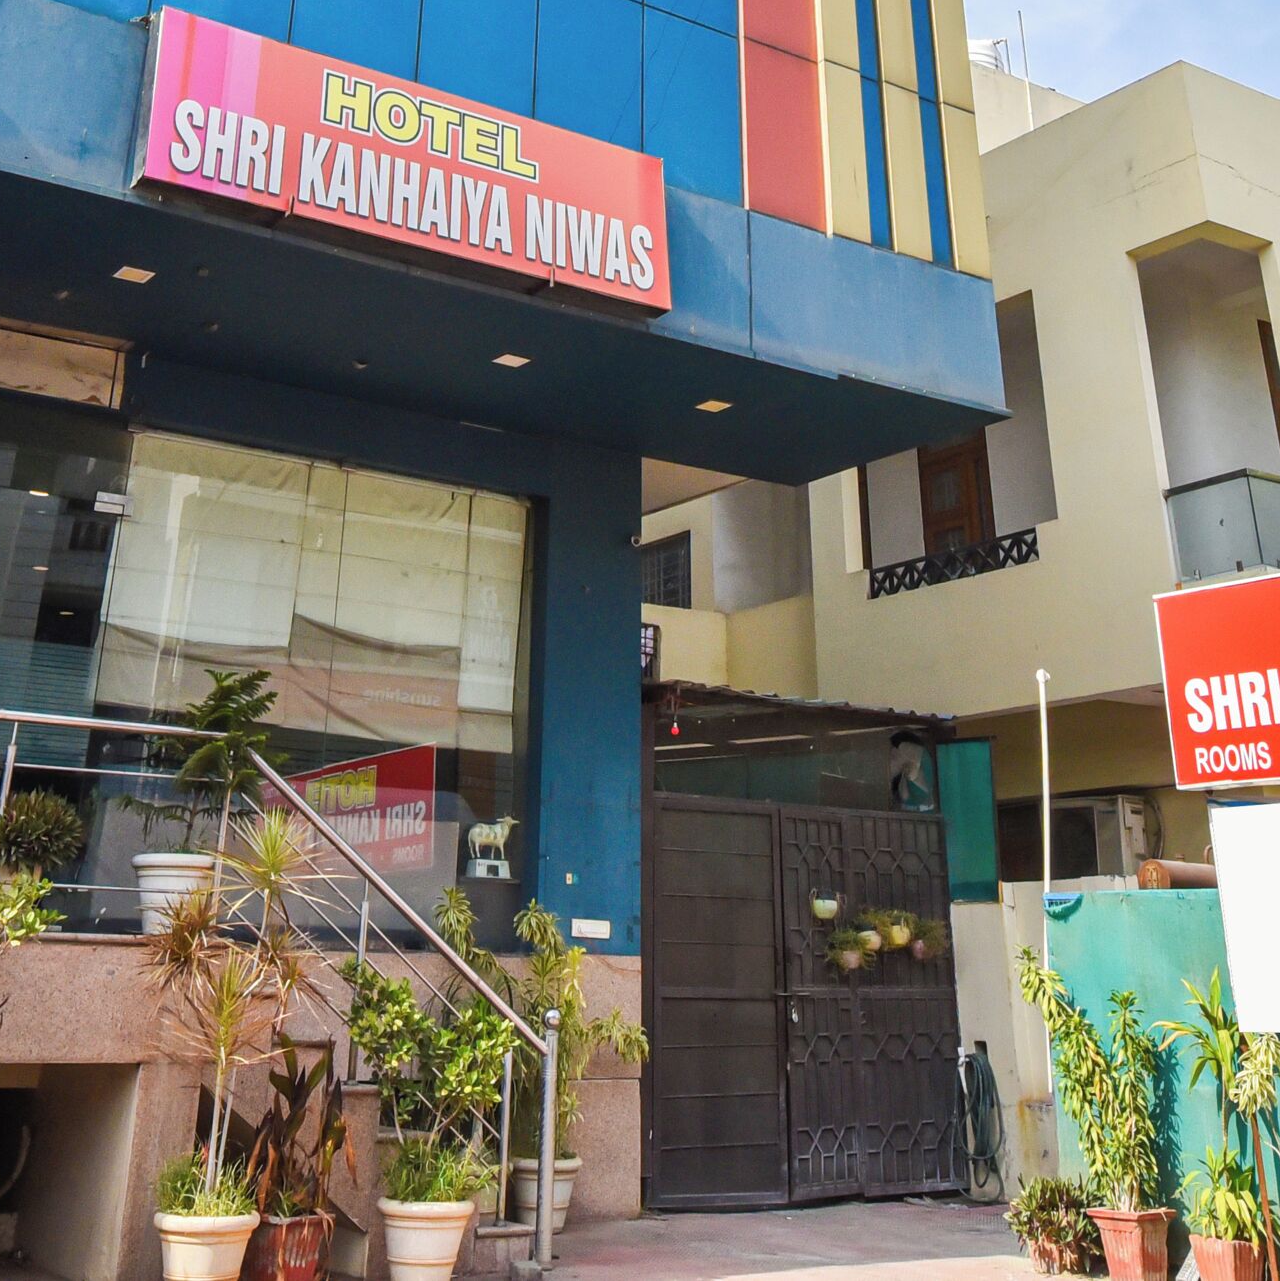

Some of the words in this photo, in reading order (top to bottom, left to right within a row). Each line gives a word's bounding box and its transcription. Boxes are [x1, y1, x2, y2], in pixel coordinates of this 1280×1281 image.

[321, 68, 539, 183] HOTEL
[169, 99, 286, 195] SHRI
[297, 131, 513, 256] KANHAIYA
[525, 193, 656, 291] NIWAS
[1194, 741, 1273, 775] ROOMS
